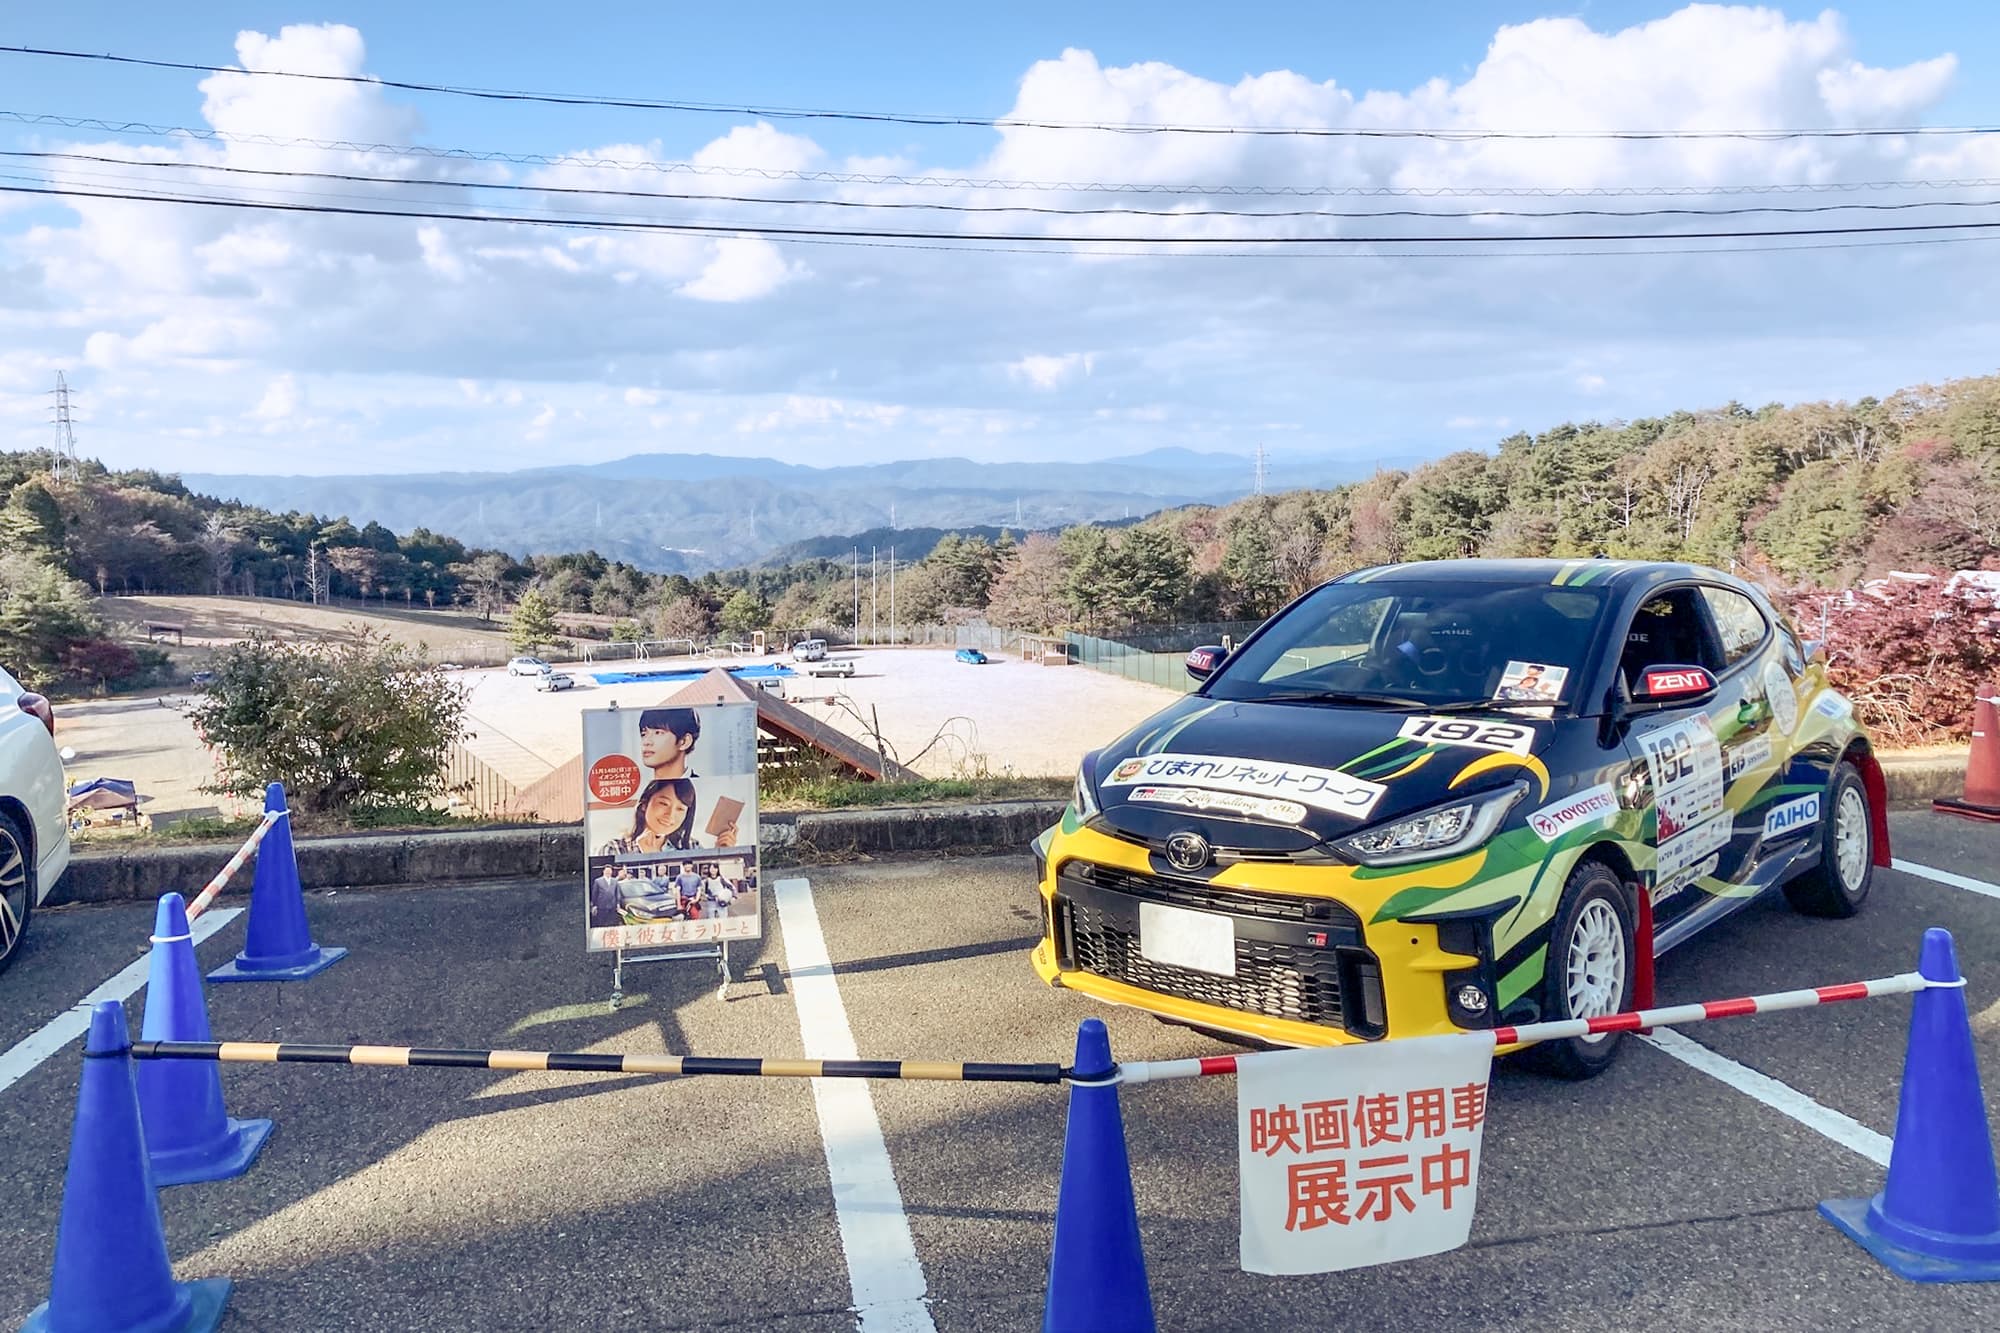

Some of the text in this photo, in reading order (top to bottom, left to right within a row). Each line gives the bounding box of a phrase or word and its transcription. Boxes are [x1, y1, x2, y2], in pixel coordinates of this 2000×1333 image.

[1652, 672, 1703, 690] ZENT
[1412, 719, 1525, 749] 192
[1648, 730, 1694, 788] 192
[599, 786, 631, 798] 公開中
[1147, 759, 1376, 806] ひまわりネットワーク
[1551, 791, 1616, 824] TOYOTETSU
[1767, 799, 1818, 833] TAIHO
[602, 921, 750, 948] 僕と彼女とラリーと
[1250, 1082, 1487, 1158] 映画使用車
[1284, 1143, 1471, 1232] 展示中
